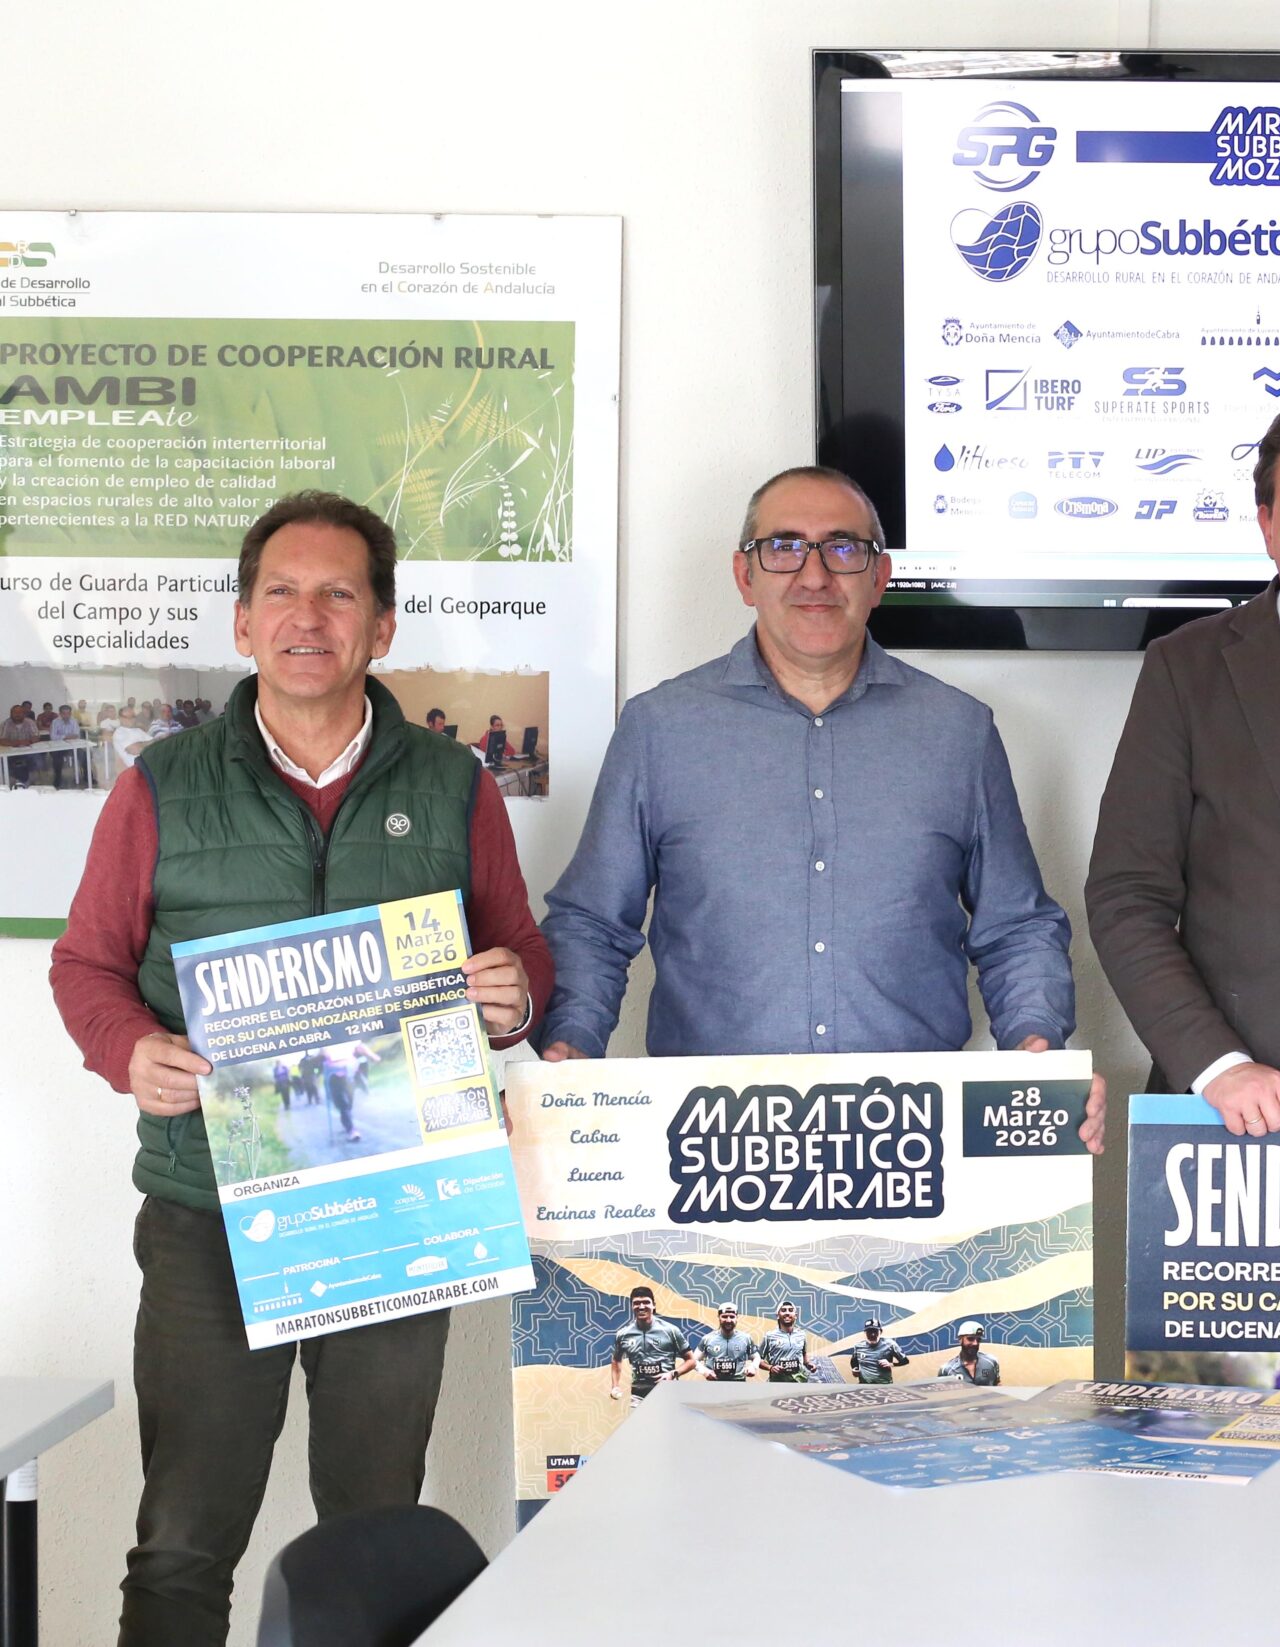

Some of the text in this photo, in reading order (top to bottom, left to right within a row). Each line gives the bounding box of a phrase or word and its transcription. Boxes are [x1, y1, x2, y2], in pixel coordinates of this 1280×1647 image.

[953, 127, 1058, 167] SPG
[378, 261, 536, 276] Desarrollo Sostenible
[1046, 270, 1110, 284] DESARROLLO
[1115, 271, 1146, 284] RURAL
[1151, 271, 1166, 284] EN
[1170, 271, 1182, 284] EL
[1186, 270, 1233, 285] CORAZÓN
[1238, 272, 1252, 285] DE
[1, 277, 91, 289] de Desarrollo
[360, 280, 556, 295] en el Corazón de Andalucía
[10, 295, 76, 307] Subbética
[965, 333, 1041, 343] Doña Mencía
[1086, 329, 1180, 340] AyuntamientodeCabra
[0, 340, 555, 370] PROYECTO DE COOPERACIÓN RURAL
[0, 376, 196, 406] AMBI
[1034, 379, 1081, 394] IBERO
[1034, 396, 1075, 411] TURF
[1094, 401, 1209, 414] SUPERATE SPORTS
[0, 434, 326, 452] Estrategia de cooperación interterritorial
[0, 453, 336, 473] para el fomento de la capacitación laboral
[1049, 470, 1101, 479] TELECOM
[37, 600, 198, 626] del Campo y sus
[404, 594, 546, 620] del Geoparque
[53, 630, 189, 654] especialidades
[403, 909, 440, 931] 14
[396, 929, 455, 951] Marzo
[402, 944, 457, 970] 2026
[195, 931, 382, 1015] SENDERISMO
[204, 973, 465, 1034] RECORRE EL CORAZÓN DE LA SUBBÉTICA
[345, 1020, 384, 1035] 12 KM
[540, 1090, 653, 1108] Doña Mencía
[1011, 1087, 1041, 1106] 28
[679, 1089, 932, 1134] MARATÓN
[983, 1106, 1069, 1129] Marzo
[570, 1129, 620, 1144] Cabra
[995, 1128, 1057, 1146] 2026
[680, 1130, 932, 1169] SUBBÉTICO
[567, 1167, 625, 1182] Lucena
[233, 1176, 300, 1197] ORGANIZA
[681, 1168, 933, 1213] MOZÁRABE
[536, 1203, 656, 1221] Encinas Reales
[423, 1227, 480, 1246] COLABORA
[276, 1276, 499, 1334] MARATONSUBBETICOMOZARABE.COM
[1164, 1320, 1194, 1338] DE
[1065, 1381, 1264, 1405] SENDERISMO
[550, 1458, 576, 1466] UTMB
